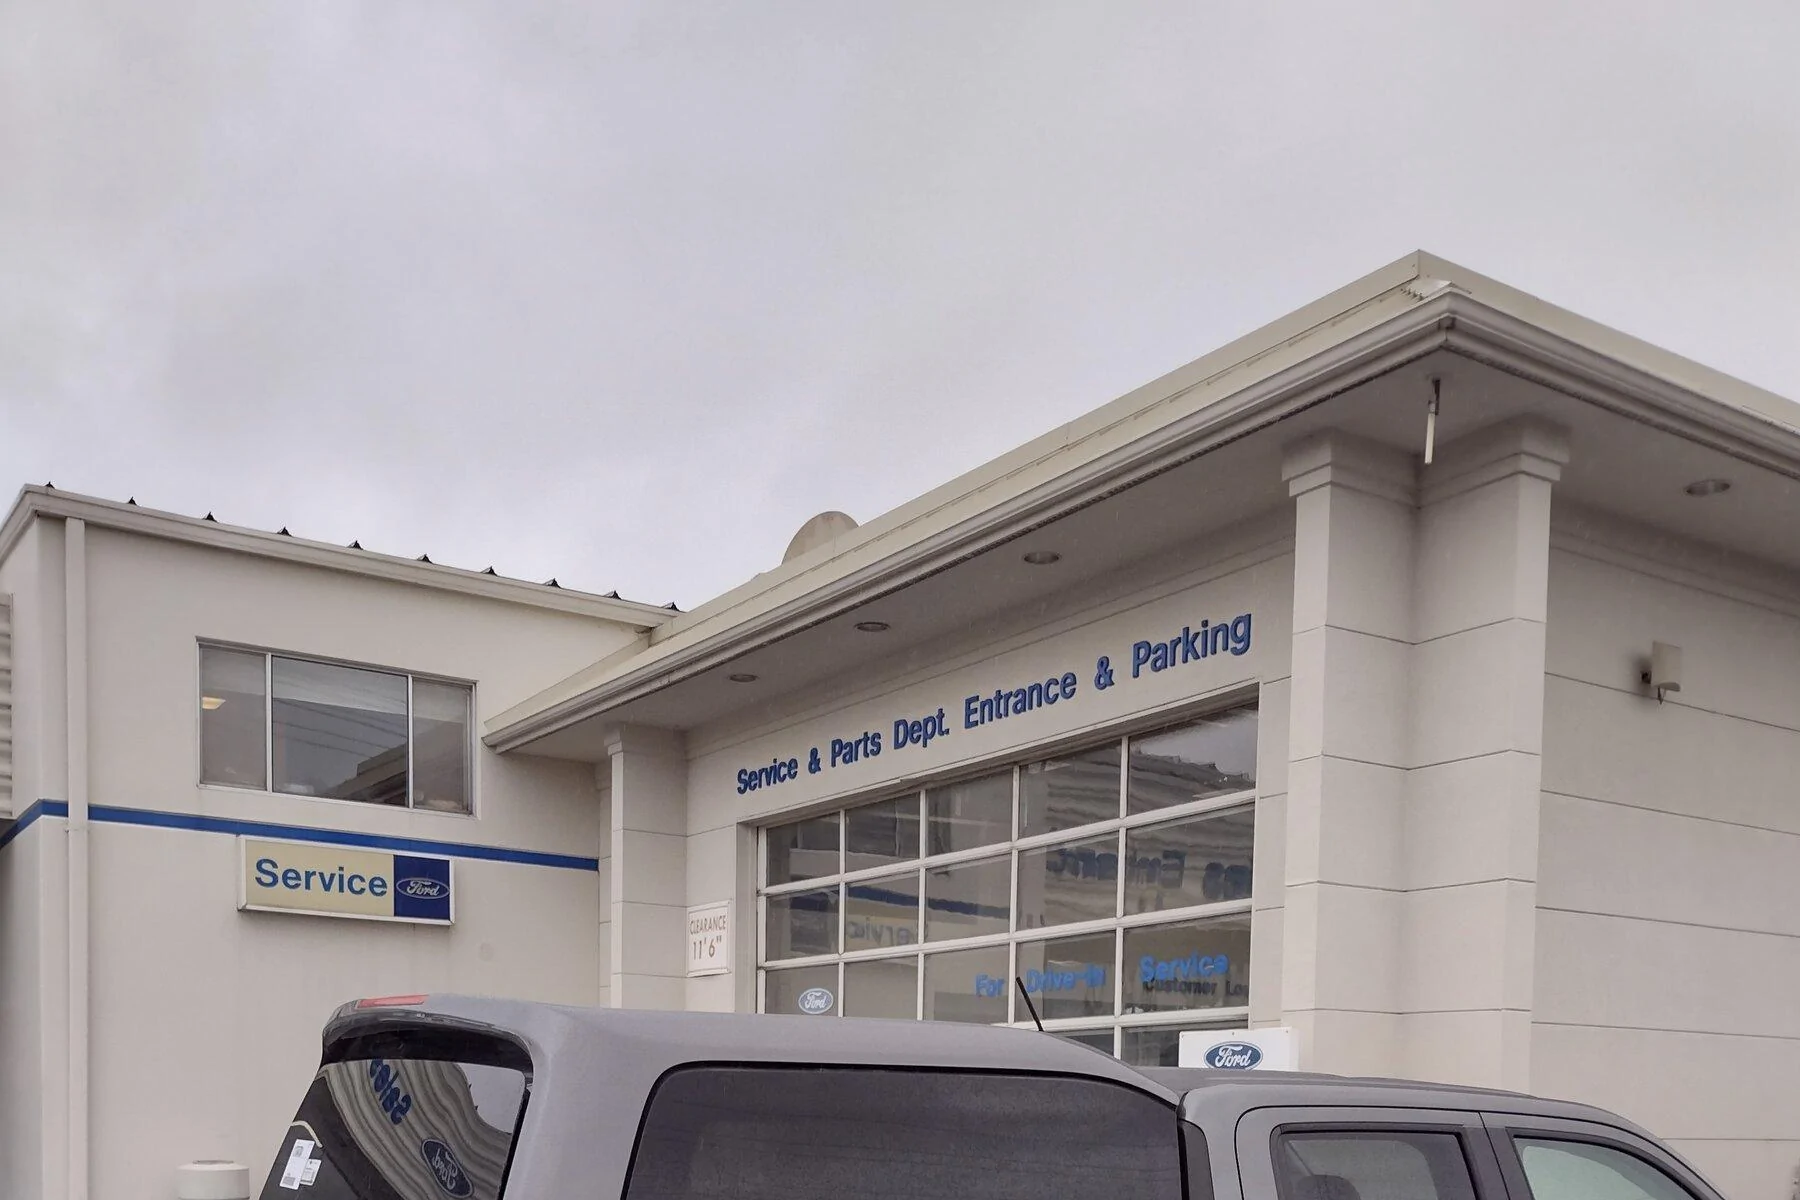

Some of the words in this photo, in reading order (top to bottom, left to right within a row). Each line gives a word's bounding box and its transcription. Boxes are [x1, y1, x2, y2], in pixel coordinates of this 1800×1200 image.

[737, 758, 798, 794] Service
[808, 748, 821, 774] &
[831, 731, 882, 767] Parts
[894, 708, 950, 748] Dept.
[964, 672, 1077, 729] Entrance
[1094, 656, 1115, 690] &
[1132, 613, 1252, 678] Parking
[255, 858, 388, 897] Service
[690, 915, 727, 935] CLEARANCE
[975, 973, 1004, 997] For
[1139, 951, 1229, 983] Service
